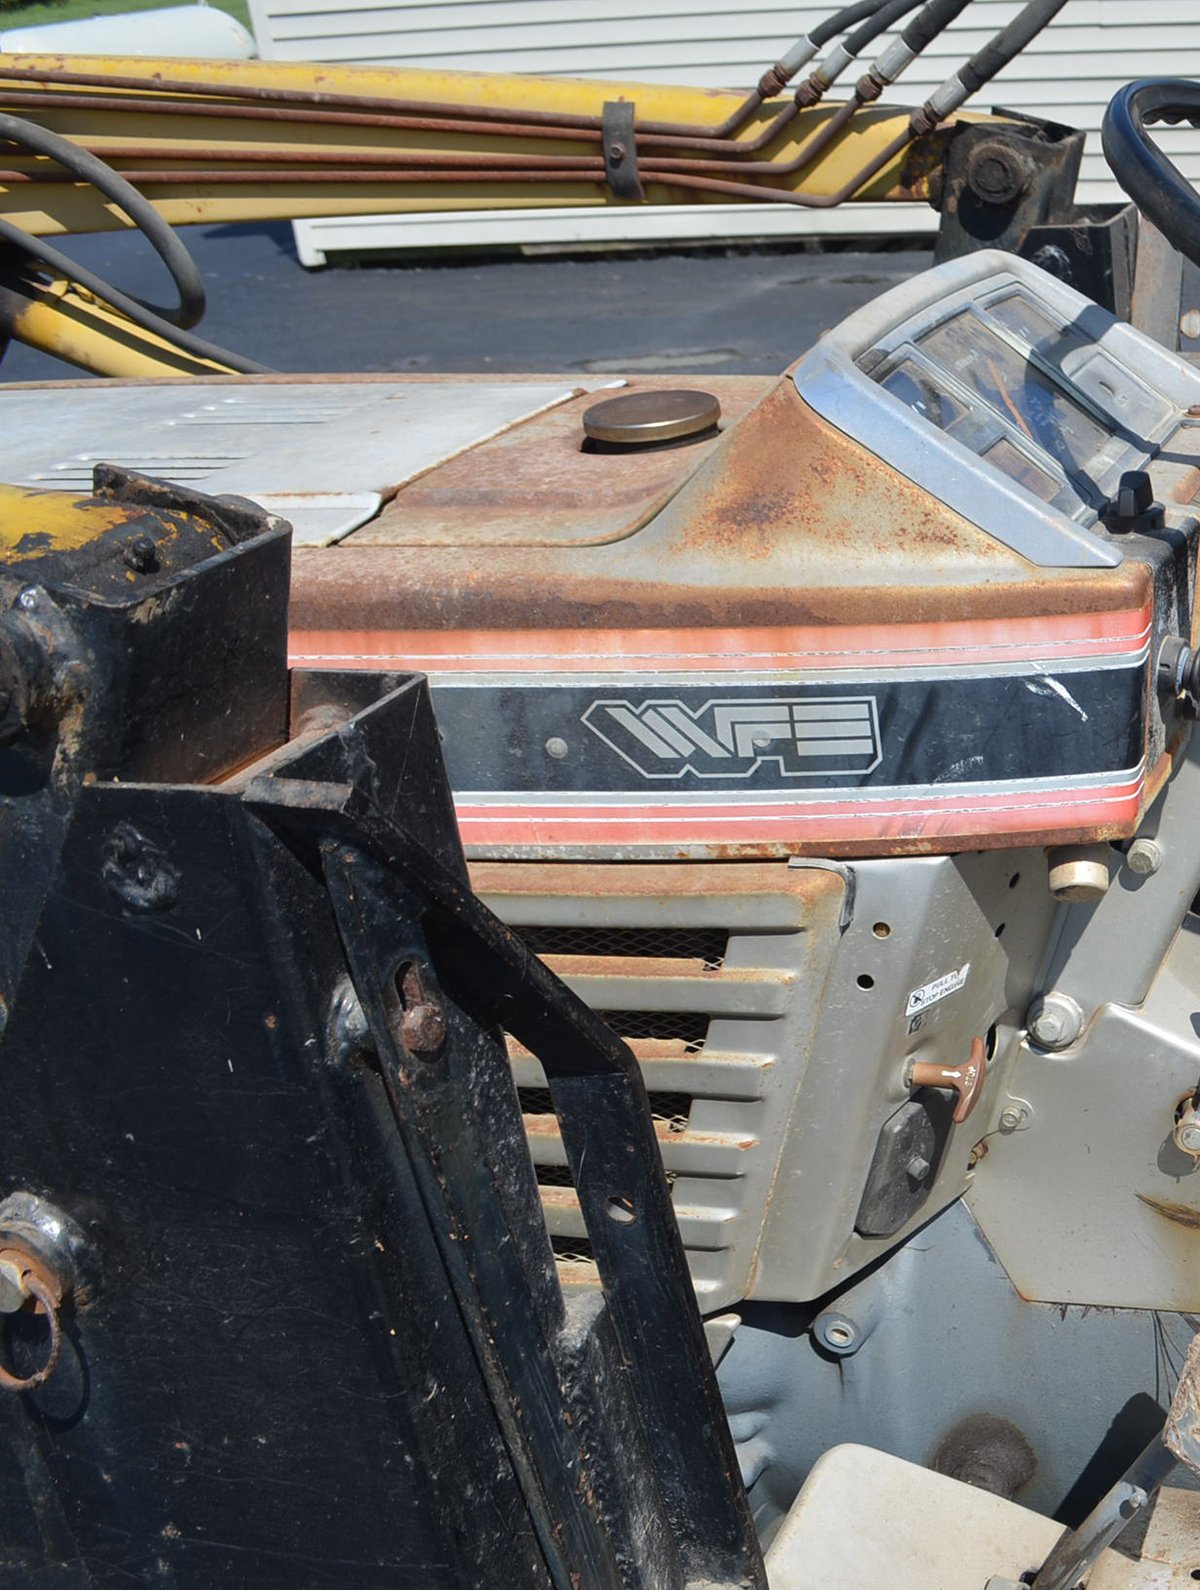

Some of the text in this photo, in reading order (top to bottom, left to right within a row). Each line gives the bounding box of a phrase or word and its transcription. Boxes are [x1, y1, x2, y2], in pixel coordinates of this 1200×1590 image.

[920, 977, 964, 1006] STOP ENGINE
[932, 978, 949, 990] PULL
[964, 1066, 976, 1087] STOP
